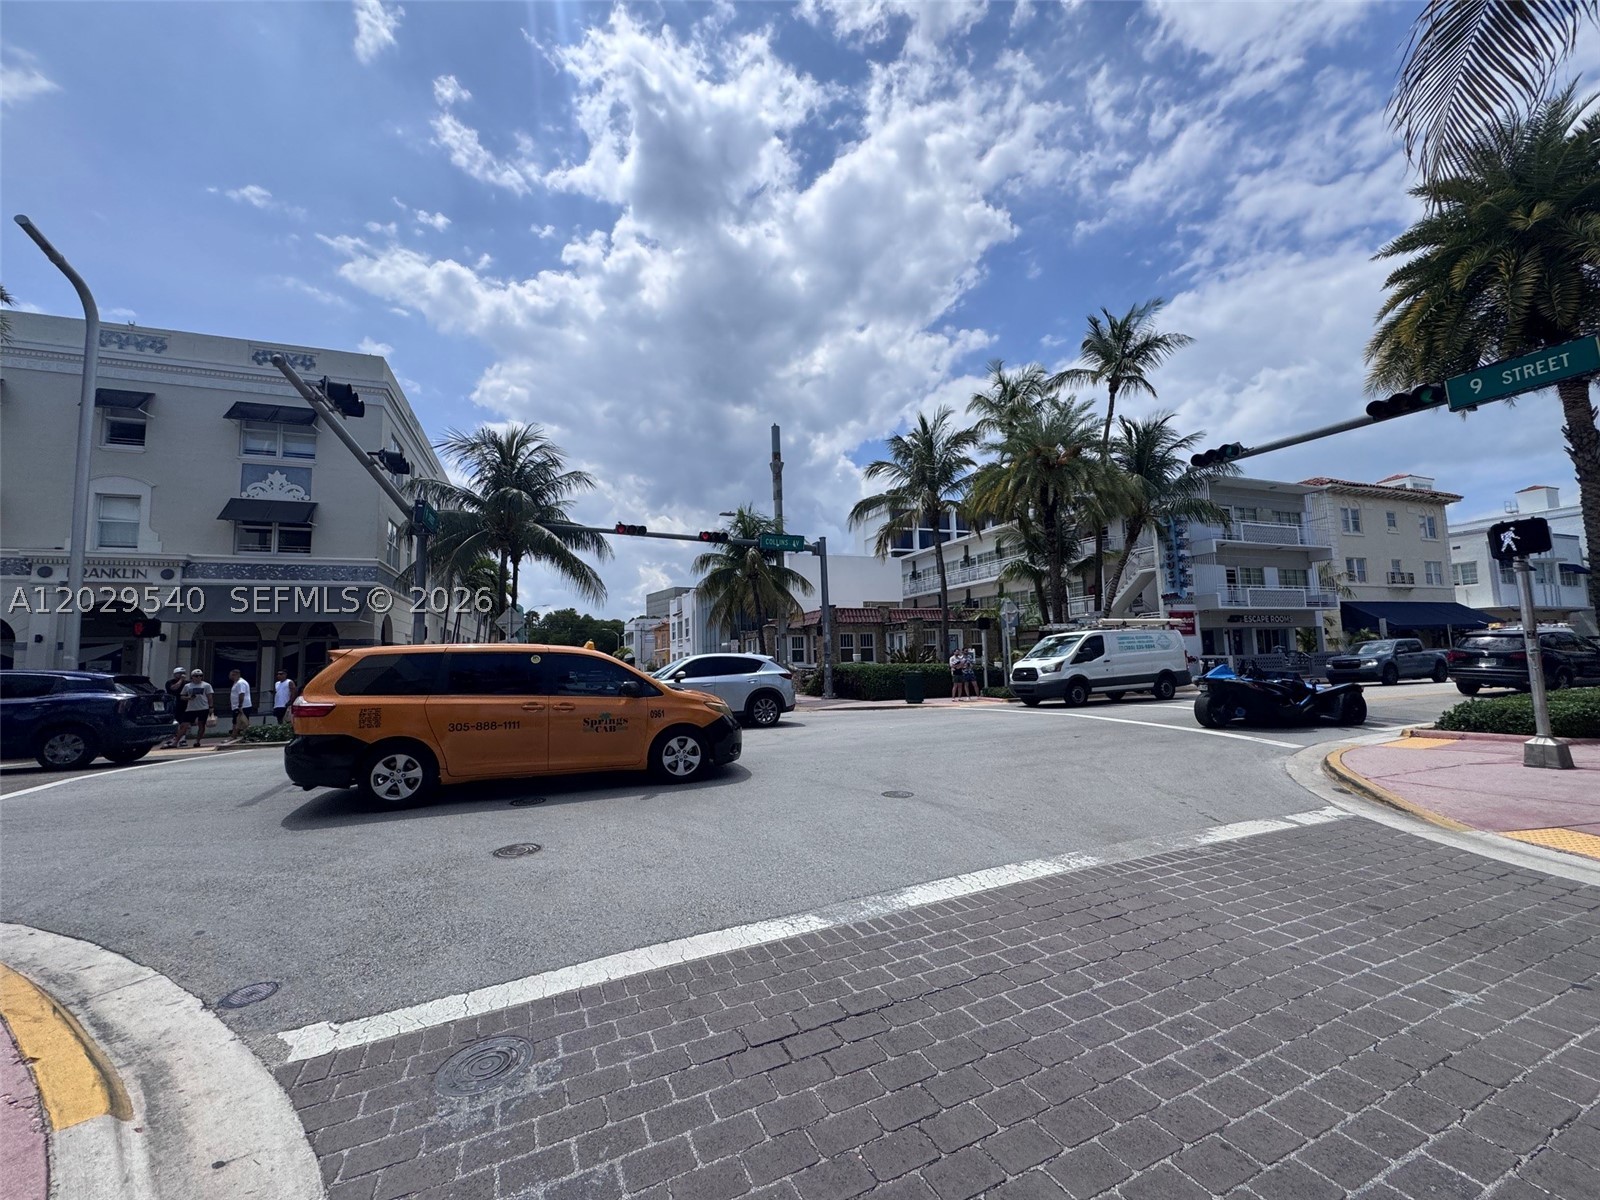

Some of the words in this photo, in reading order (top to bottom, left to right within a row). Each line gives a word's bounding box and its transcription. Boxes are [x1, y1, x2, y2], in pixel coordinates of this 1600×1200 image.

[1469, 377, 1483, 395] 9
[1501, 352, 1570, 385] STREET
[765, 537, 789, 547] COLLINS
[67, 567, 148, 579] RANKLIN
[1243, 614, 1269, 623] ESCAPE
[1270, 614, 1294, 623] ROOMS
[448, 720, 520, 732] 305-888-1111
[583, 716, 629, 728] Springs
